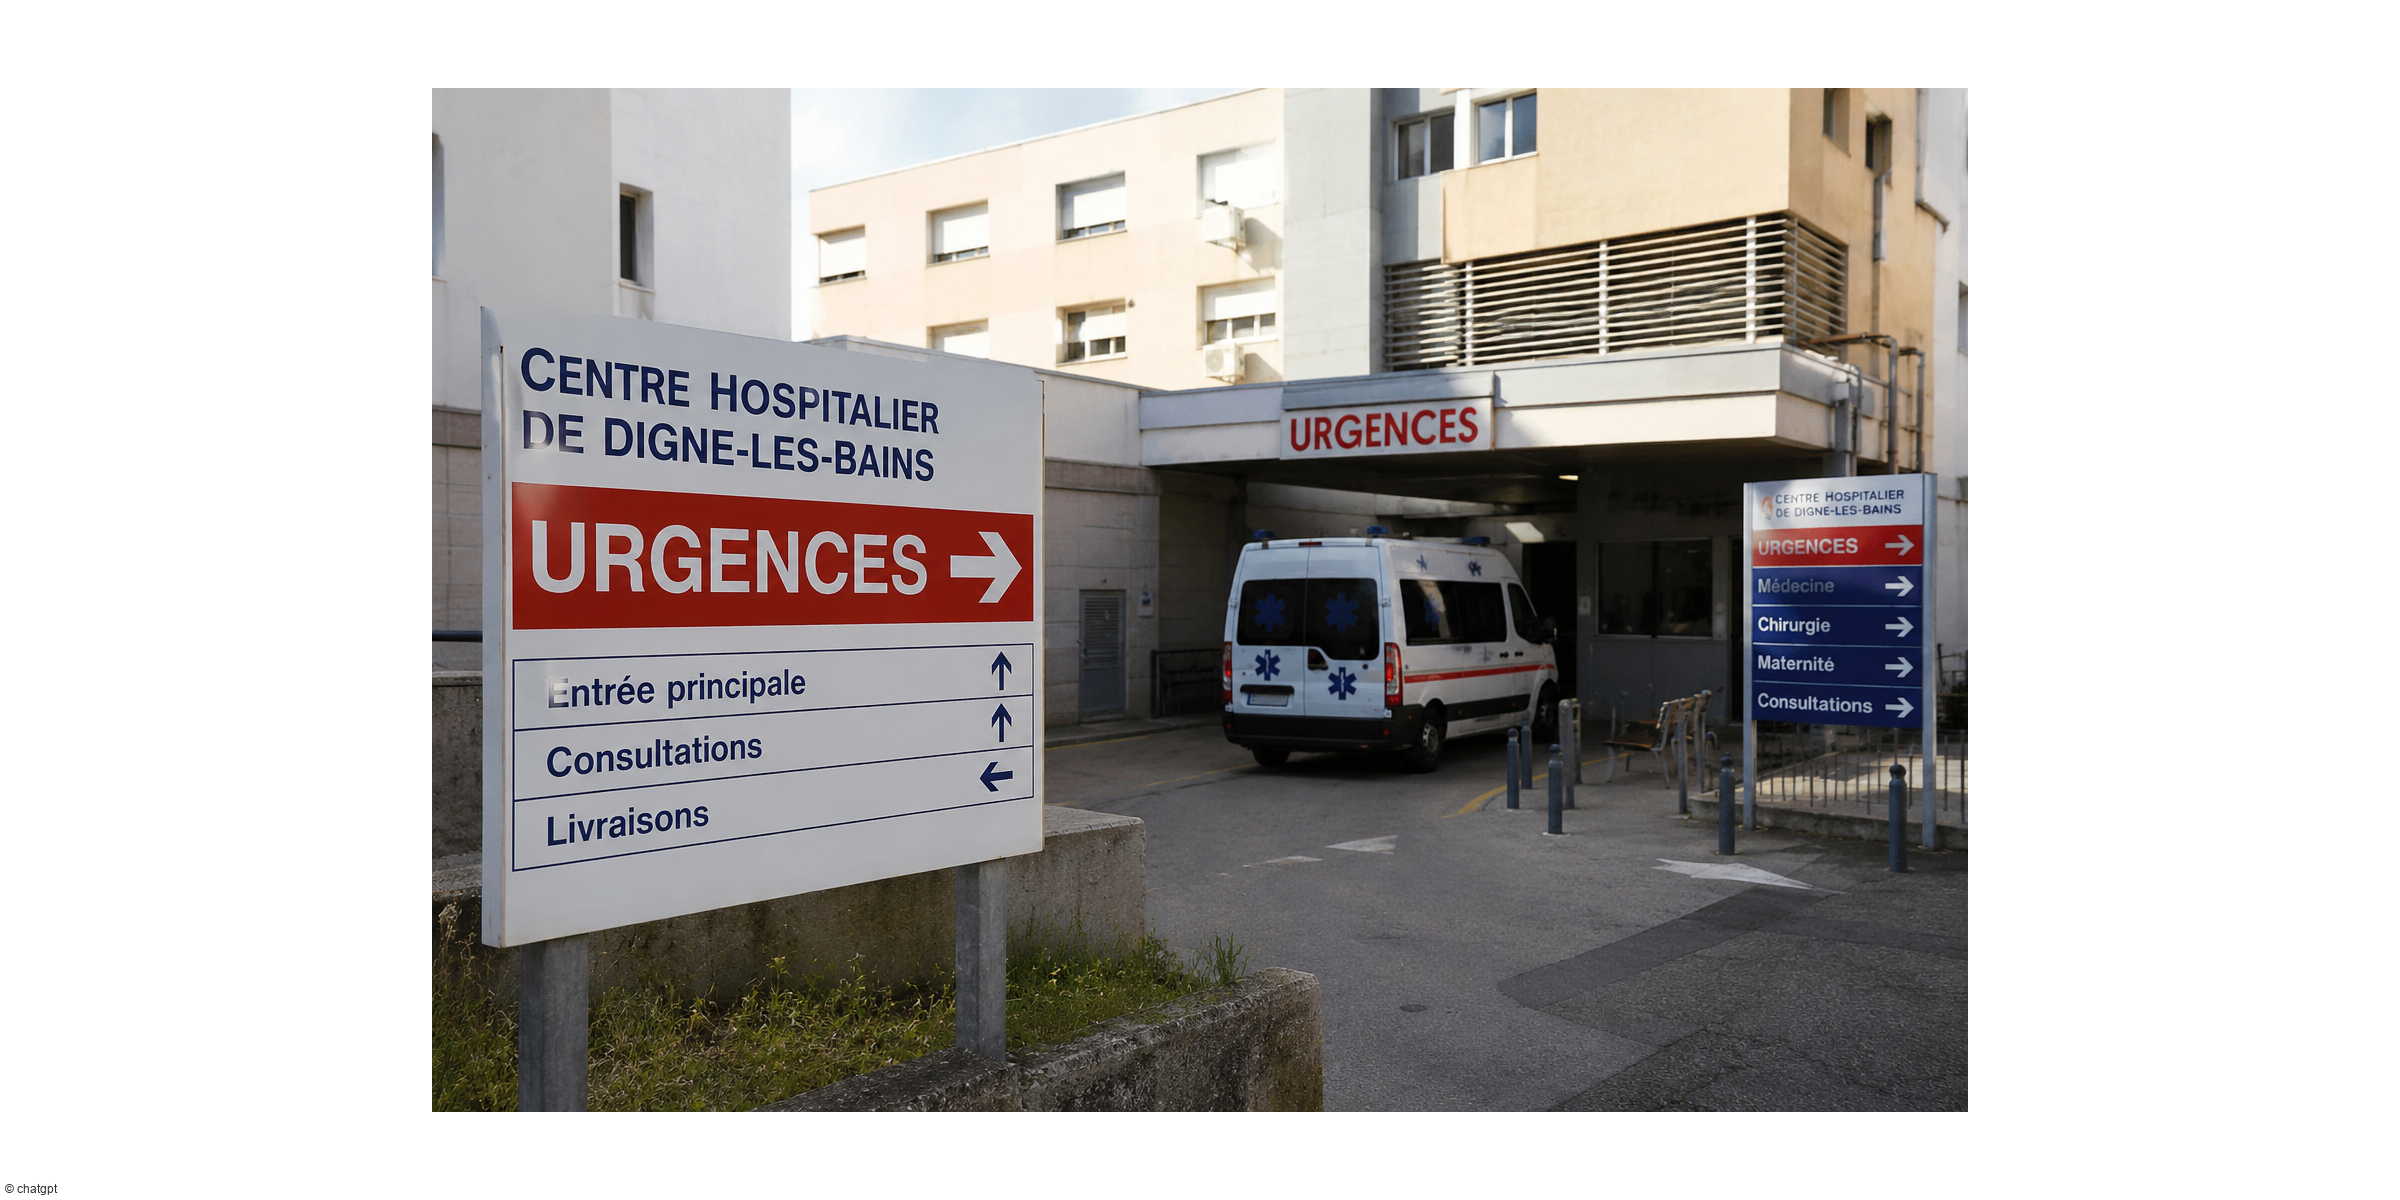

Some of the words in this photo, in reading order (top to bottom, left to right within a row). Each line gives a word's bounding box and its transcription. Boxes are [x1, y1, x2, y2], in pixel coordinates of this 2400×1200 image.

[520, 346, 690, 407] CENTRE
[710, 371, 940, 434] HOSPITALIER
[1290, 406, 1479, 452] URGENCES
[523, 409, 585, 454] DE
[604, 416, 935, 482] DIGNE-LES-BAINS
[1775, 492, 1820, 505] CENTRE
[1825, 489, 1905, 502] HOSPITALIER
[1776, 507, 1790, 518] DE
[1794, 504, 1902, 517] DIGNE-LES-BAINS
[531, 519, 928, 594] URGENCES
[1758, 537, 1859, 556] URGENCES
[1758, 577, 1835, 594] Médecine
[1757, 616, 1831, 636] Chirurgie
[1757, 654, 1835, 672] Maternité
[548, 675, 655, 710] Entrée
[667, 668, 807, 710] principale
[1757, 692, 1873, 714] Consultations
[546, 735, 763, 778] Consultations
[546, 803, 710, 847] Livraisons
